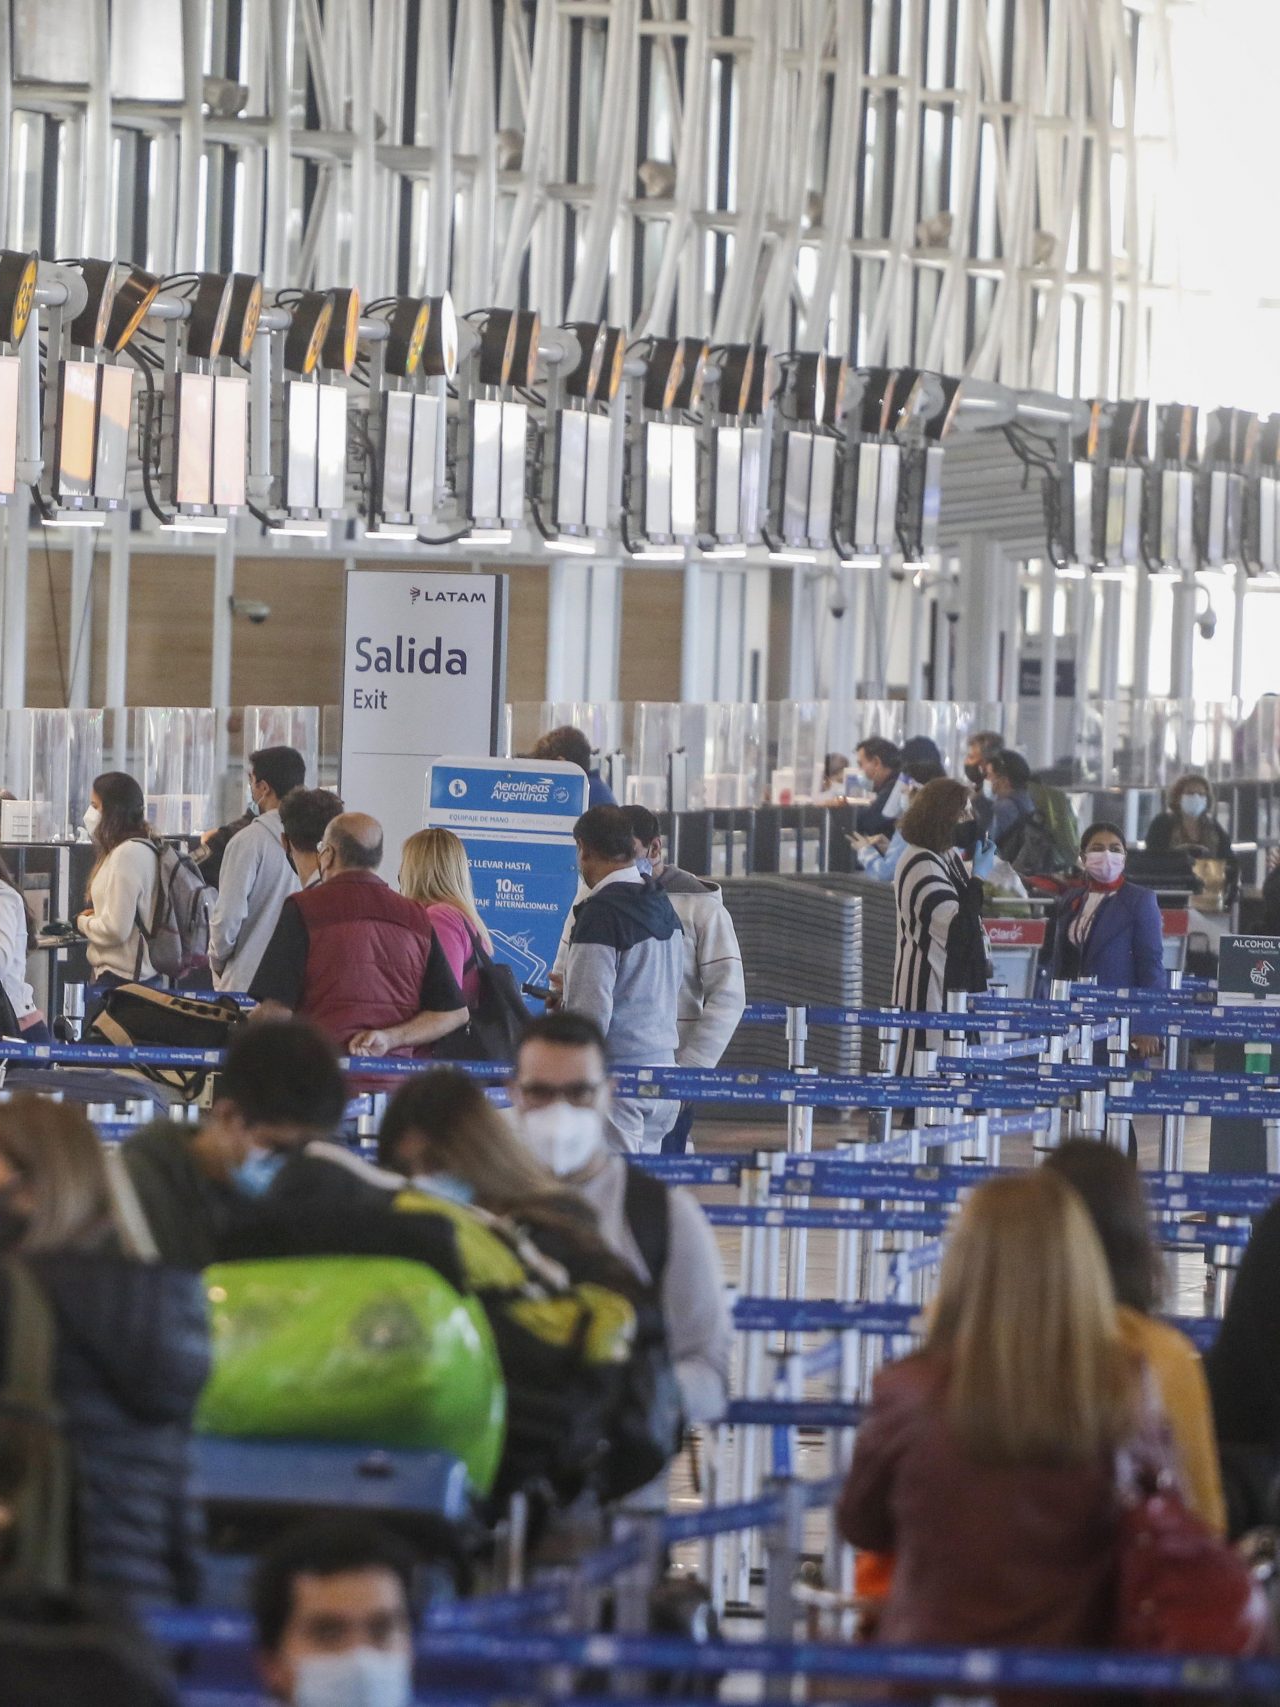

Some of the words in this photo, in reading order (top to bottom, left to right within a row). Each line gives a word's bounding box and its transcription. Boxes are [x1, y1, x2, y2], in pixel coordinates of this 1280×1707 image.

[425, 591, 486, 603] LATAM
[355, 635, 467, 675] Salida
[353, 689, 388, 710] Exit
[490, 790, 548, 802] Argentinas
[449, 813, 478, 822] EQUIPAJE
[480, 815, 488, 823] DE
[474, 860, 503, 869] LLEVAR
[505, 862, 531, 871] HASTA
[495, 893, 524, 901] VUELOS
[495, 900, 559, 911] INTERNACIONALES
[990, 928, 1017, 940] Claro
[1232, 939, 1276, 949] ALCOHOL
